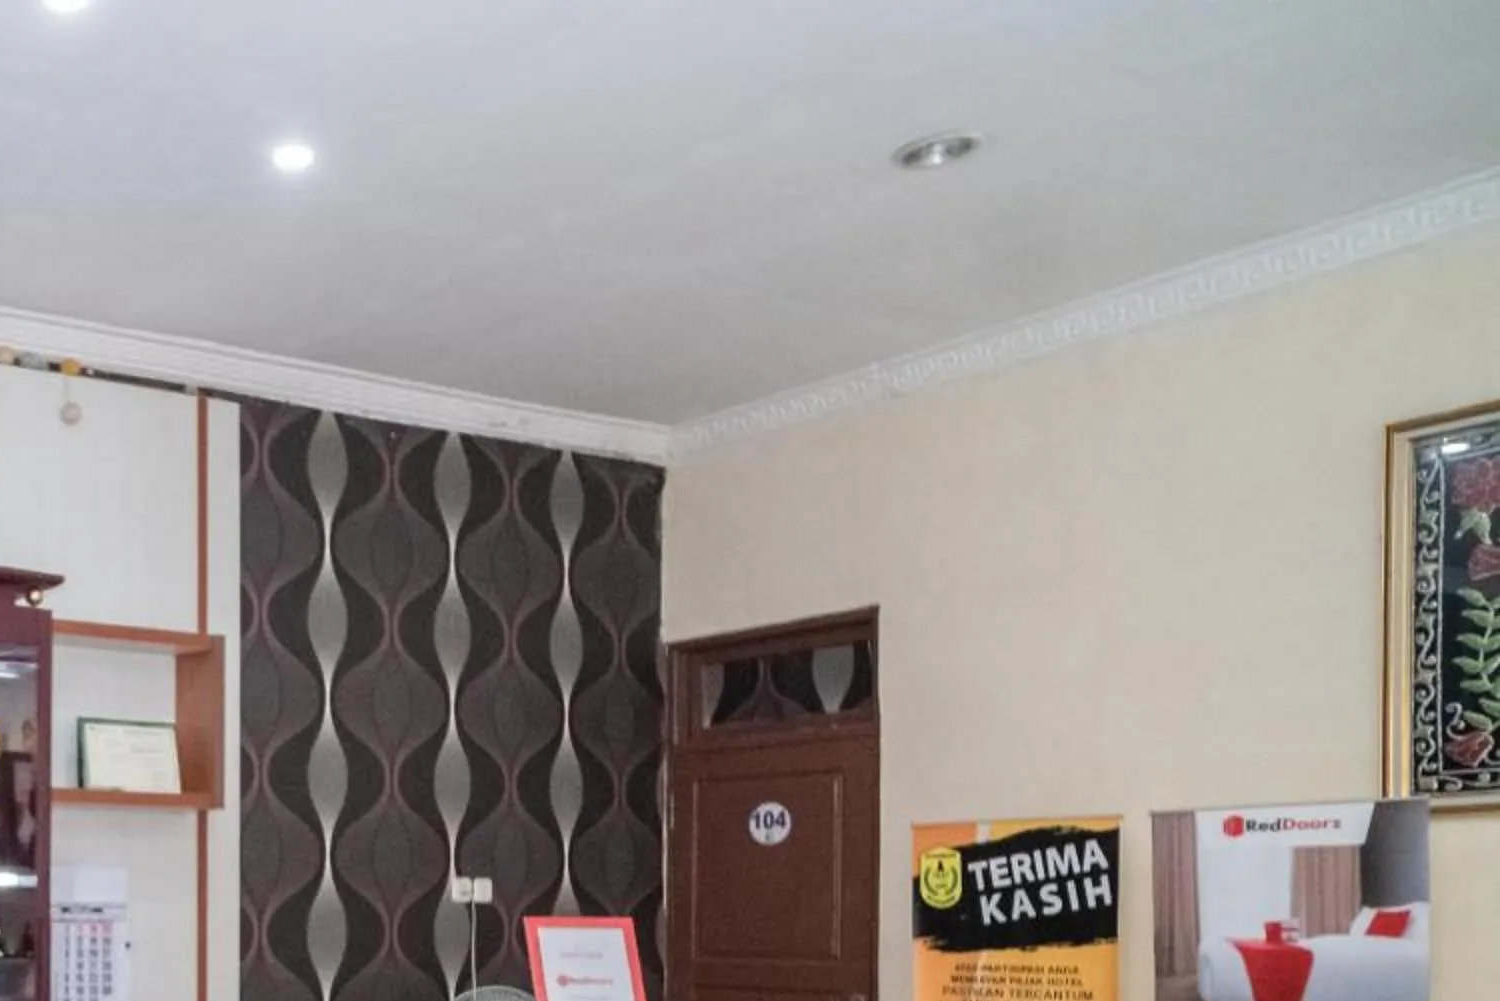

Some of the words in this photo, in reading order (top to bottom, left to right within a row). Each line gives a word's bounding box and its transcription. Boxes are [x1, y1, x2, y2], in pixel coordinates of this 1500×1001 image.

[754, 810, 786, 830] 104
[1246, 817, 1341, 832] RedDoorz
[968, 838, 1109, 892] TERIMA
[979, 874, 1113, 926] KASIH
[1009, 987, 1093, 1000] TERCANTUM
